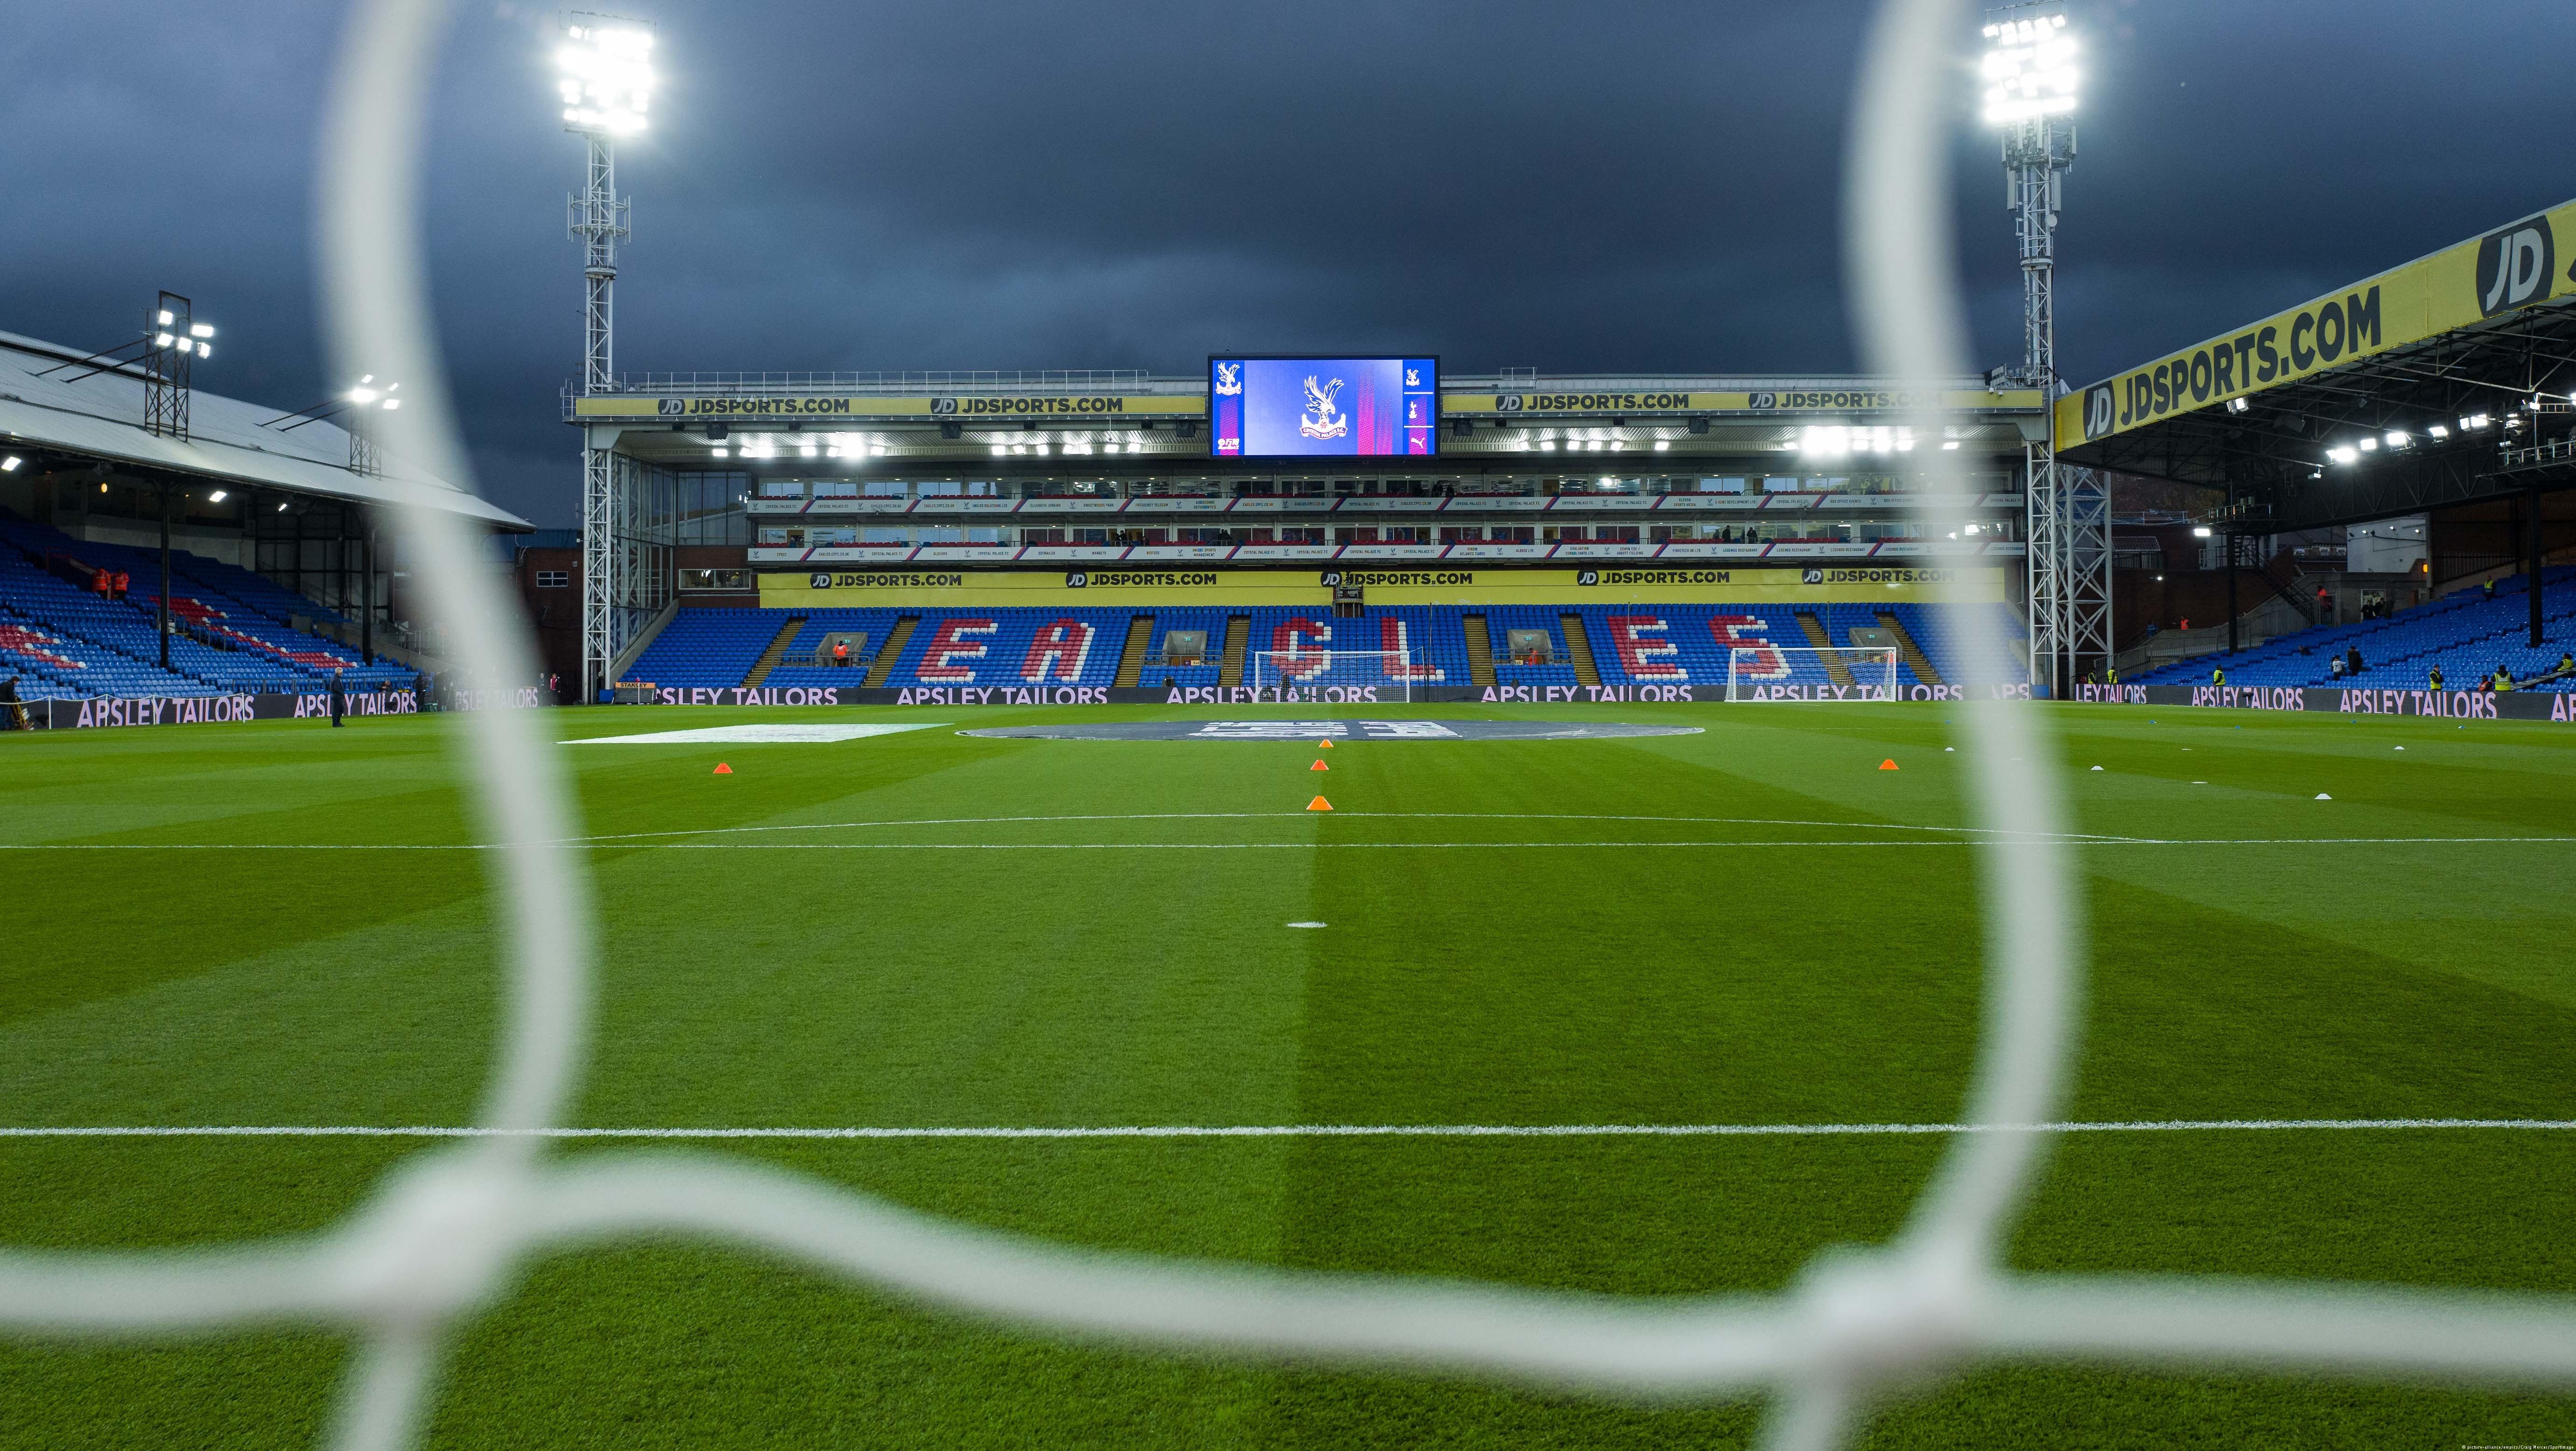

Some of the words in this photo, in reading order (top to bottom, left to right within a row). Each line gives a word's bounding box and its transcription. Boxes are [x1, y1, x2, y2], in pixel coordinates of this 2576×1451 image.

[2486, 228, 2544, 310] JD
[2086, 386, 2111, 437] JD
[2120, 286, 2381, 426] JDSPORTS.COM
[661, 400, 682, 414] JD
[689, 399, 849, 414] JDSPORTS.COM
[934, 399, 955, 413] JD
[962, 398, 1122, 413] JDSPORTS.COM
[1499, 396, 1520, 410] JD
[1528, 394, 1689, 409] JDSPORTS.COM
[1752, 394, 1773, 408] JD
[813, 575, 829, 587] JD
[835, 575, 962, 586] JDSPORTS.COM
[1069, 574, 1085, 586] JD
[1091, 574, 1216, 585] JDSPORTS.COM
[1324, 573, 1340, 585] JD
[1347, 573, 1472, 585] JDSPORTS.COM
[1580, 573, 1596, 584] JD
[1602, 571, 1730, 583] JDSPORTS.COM
[1804, 571, 1821, 582] JD
[731, 688, 838, 704] TAILORS
[897, 688, 997, 704] APSLEY
[1002, 687, 1107, 704] TAILORS
[1167, 687, 1263, 704] APSLEY
[1481, 685, 1579, 702] APSLEY
[1753, 685, 1849, 700] APSLEY
[2104, 684, 2147, 704] TAILORS
[2192, 686, 2239, 708] APSLEY
[77, 698, 166, 727] APSLEY
[172, 696, 254, 723] TAILORS
[294, 694, 354, 718] APSLY
[2340, 689, 2406, 715] APSLEY
[2411, 691, 2497, 719] TAILORS
